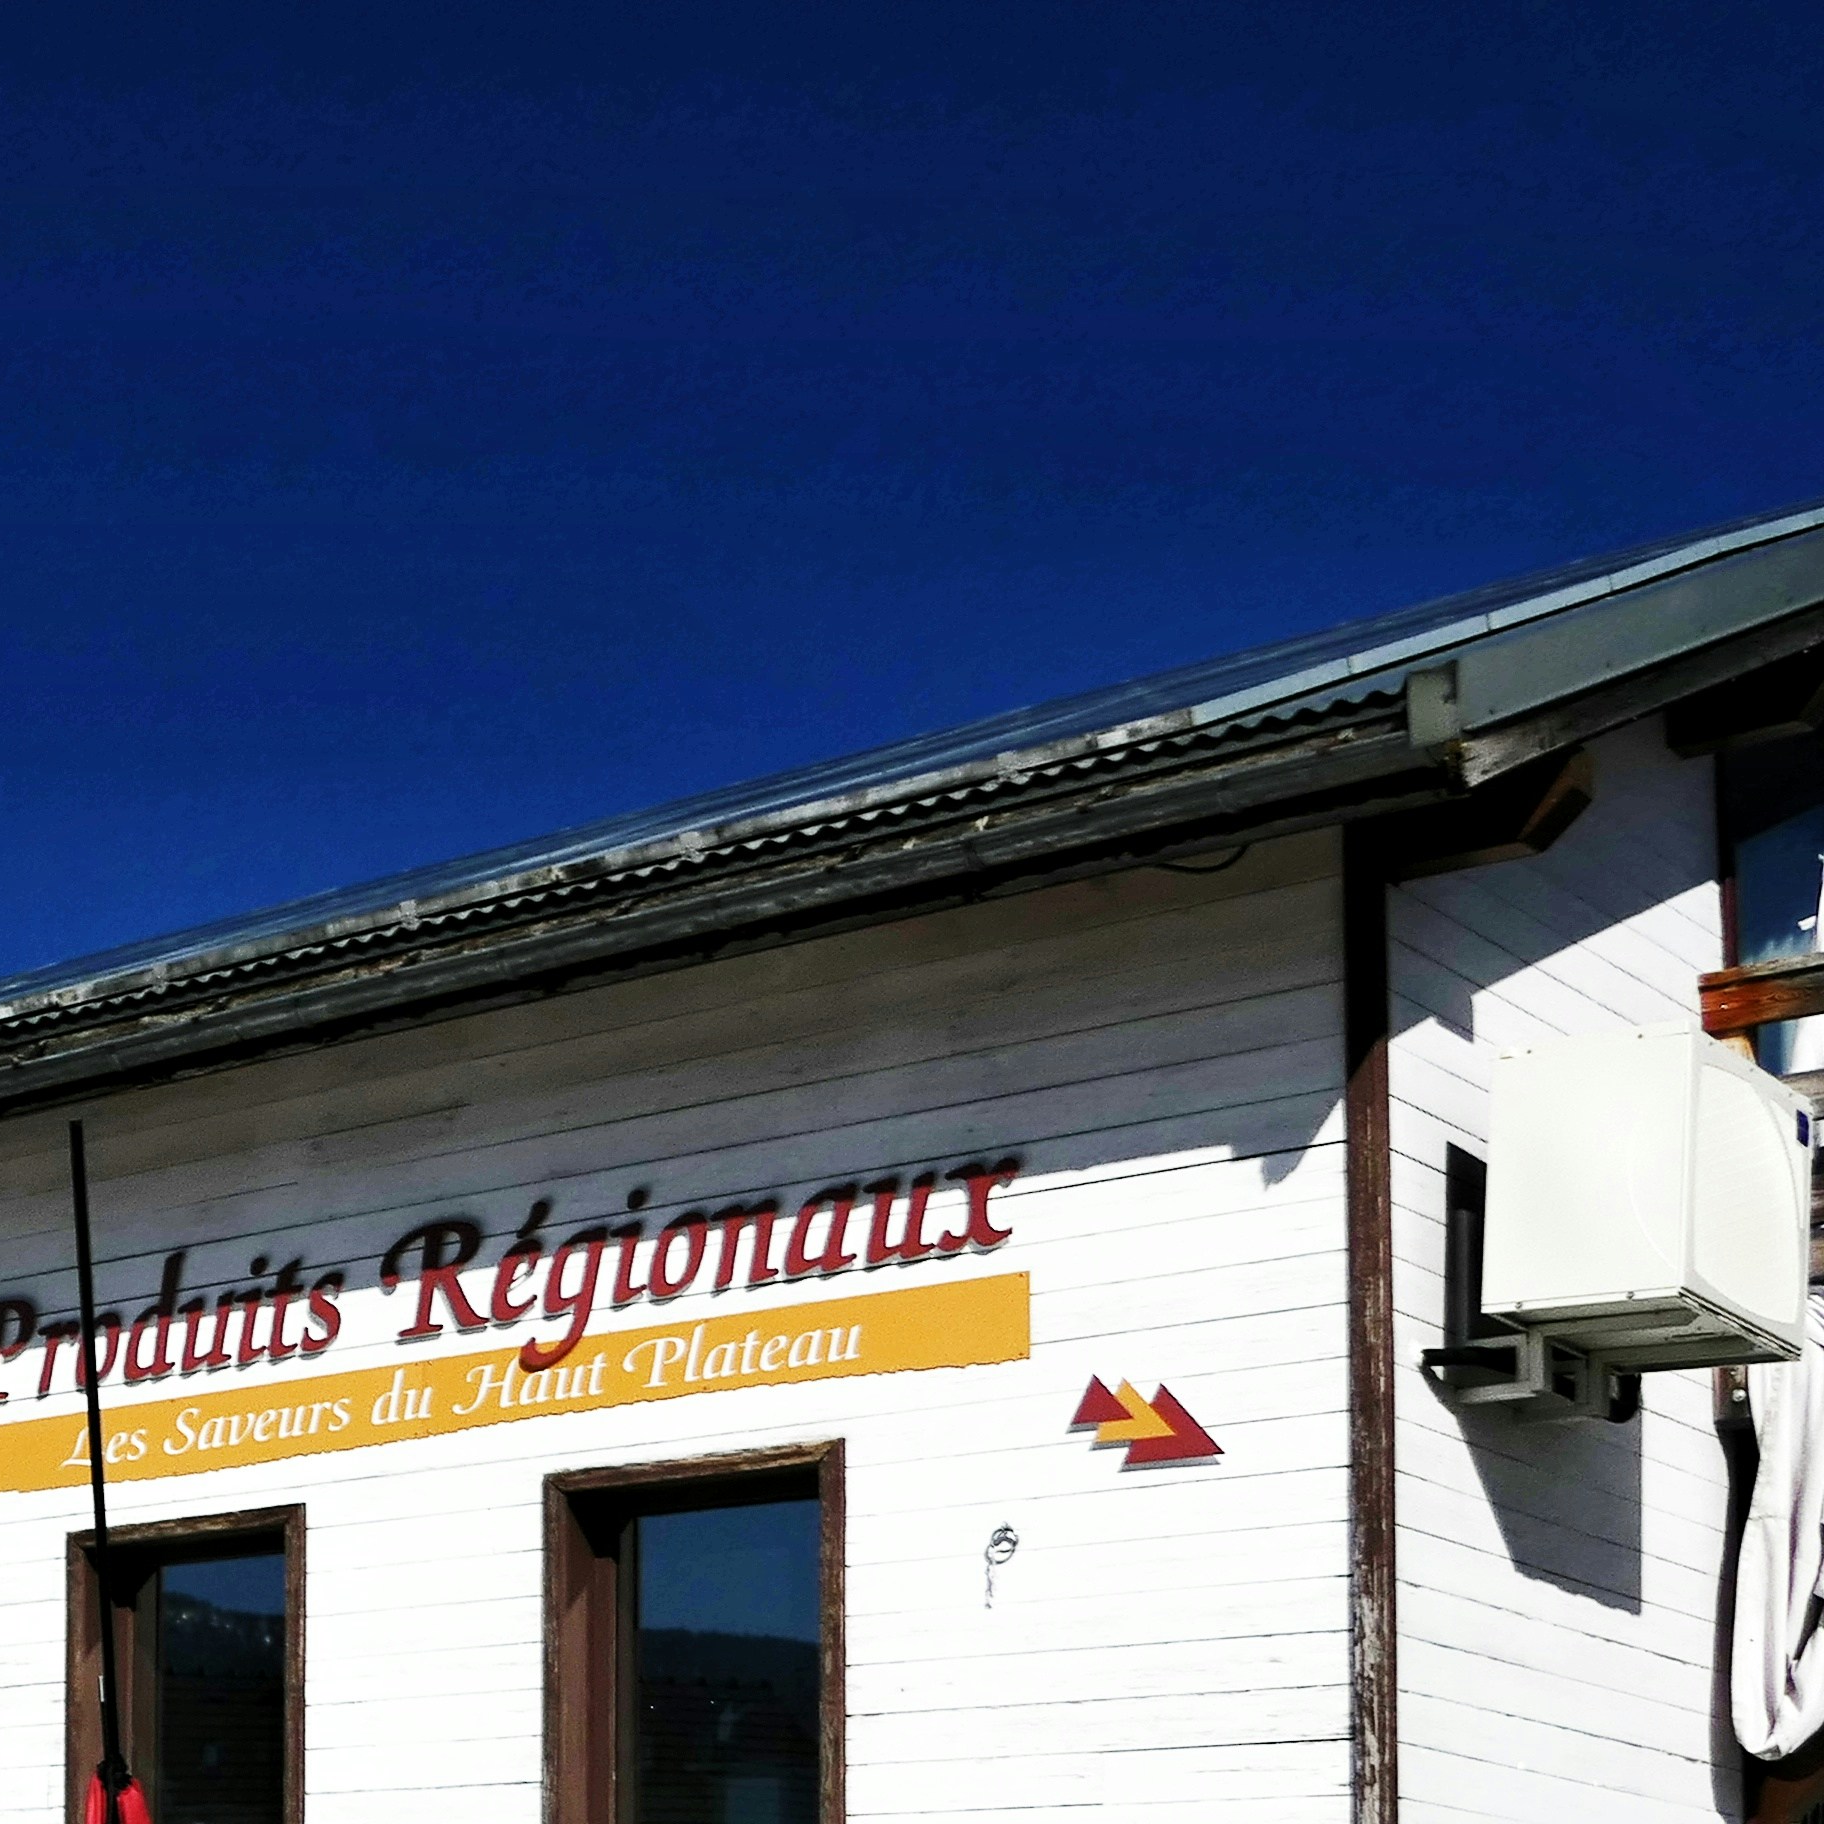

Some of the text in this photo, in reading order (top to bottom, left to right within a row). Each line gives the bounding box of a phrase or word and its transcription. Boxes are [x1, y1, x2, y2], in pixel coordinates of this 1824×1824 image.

[379, 1156, 1024, 1374] Régionaux
[162, 1394, 353, 1456] Saveurs
[370, 1367, 433, 1427] du
[452, 1350, 609, 1417] Haut
[623, 1320, 863, 1391] Plateau
